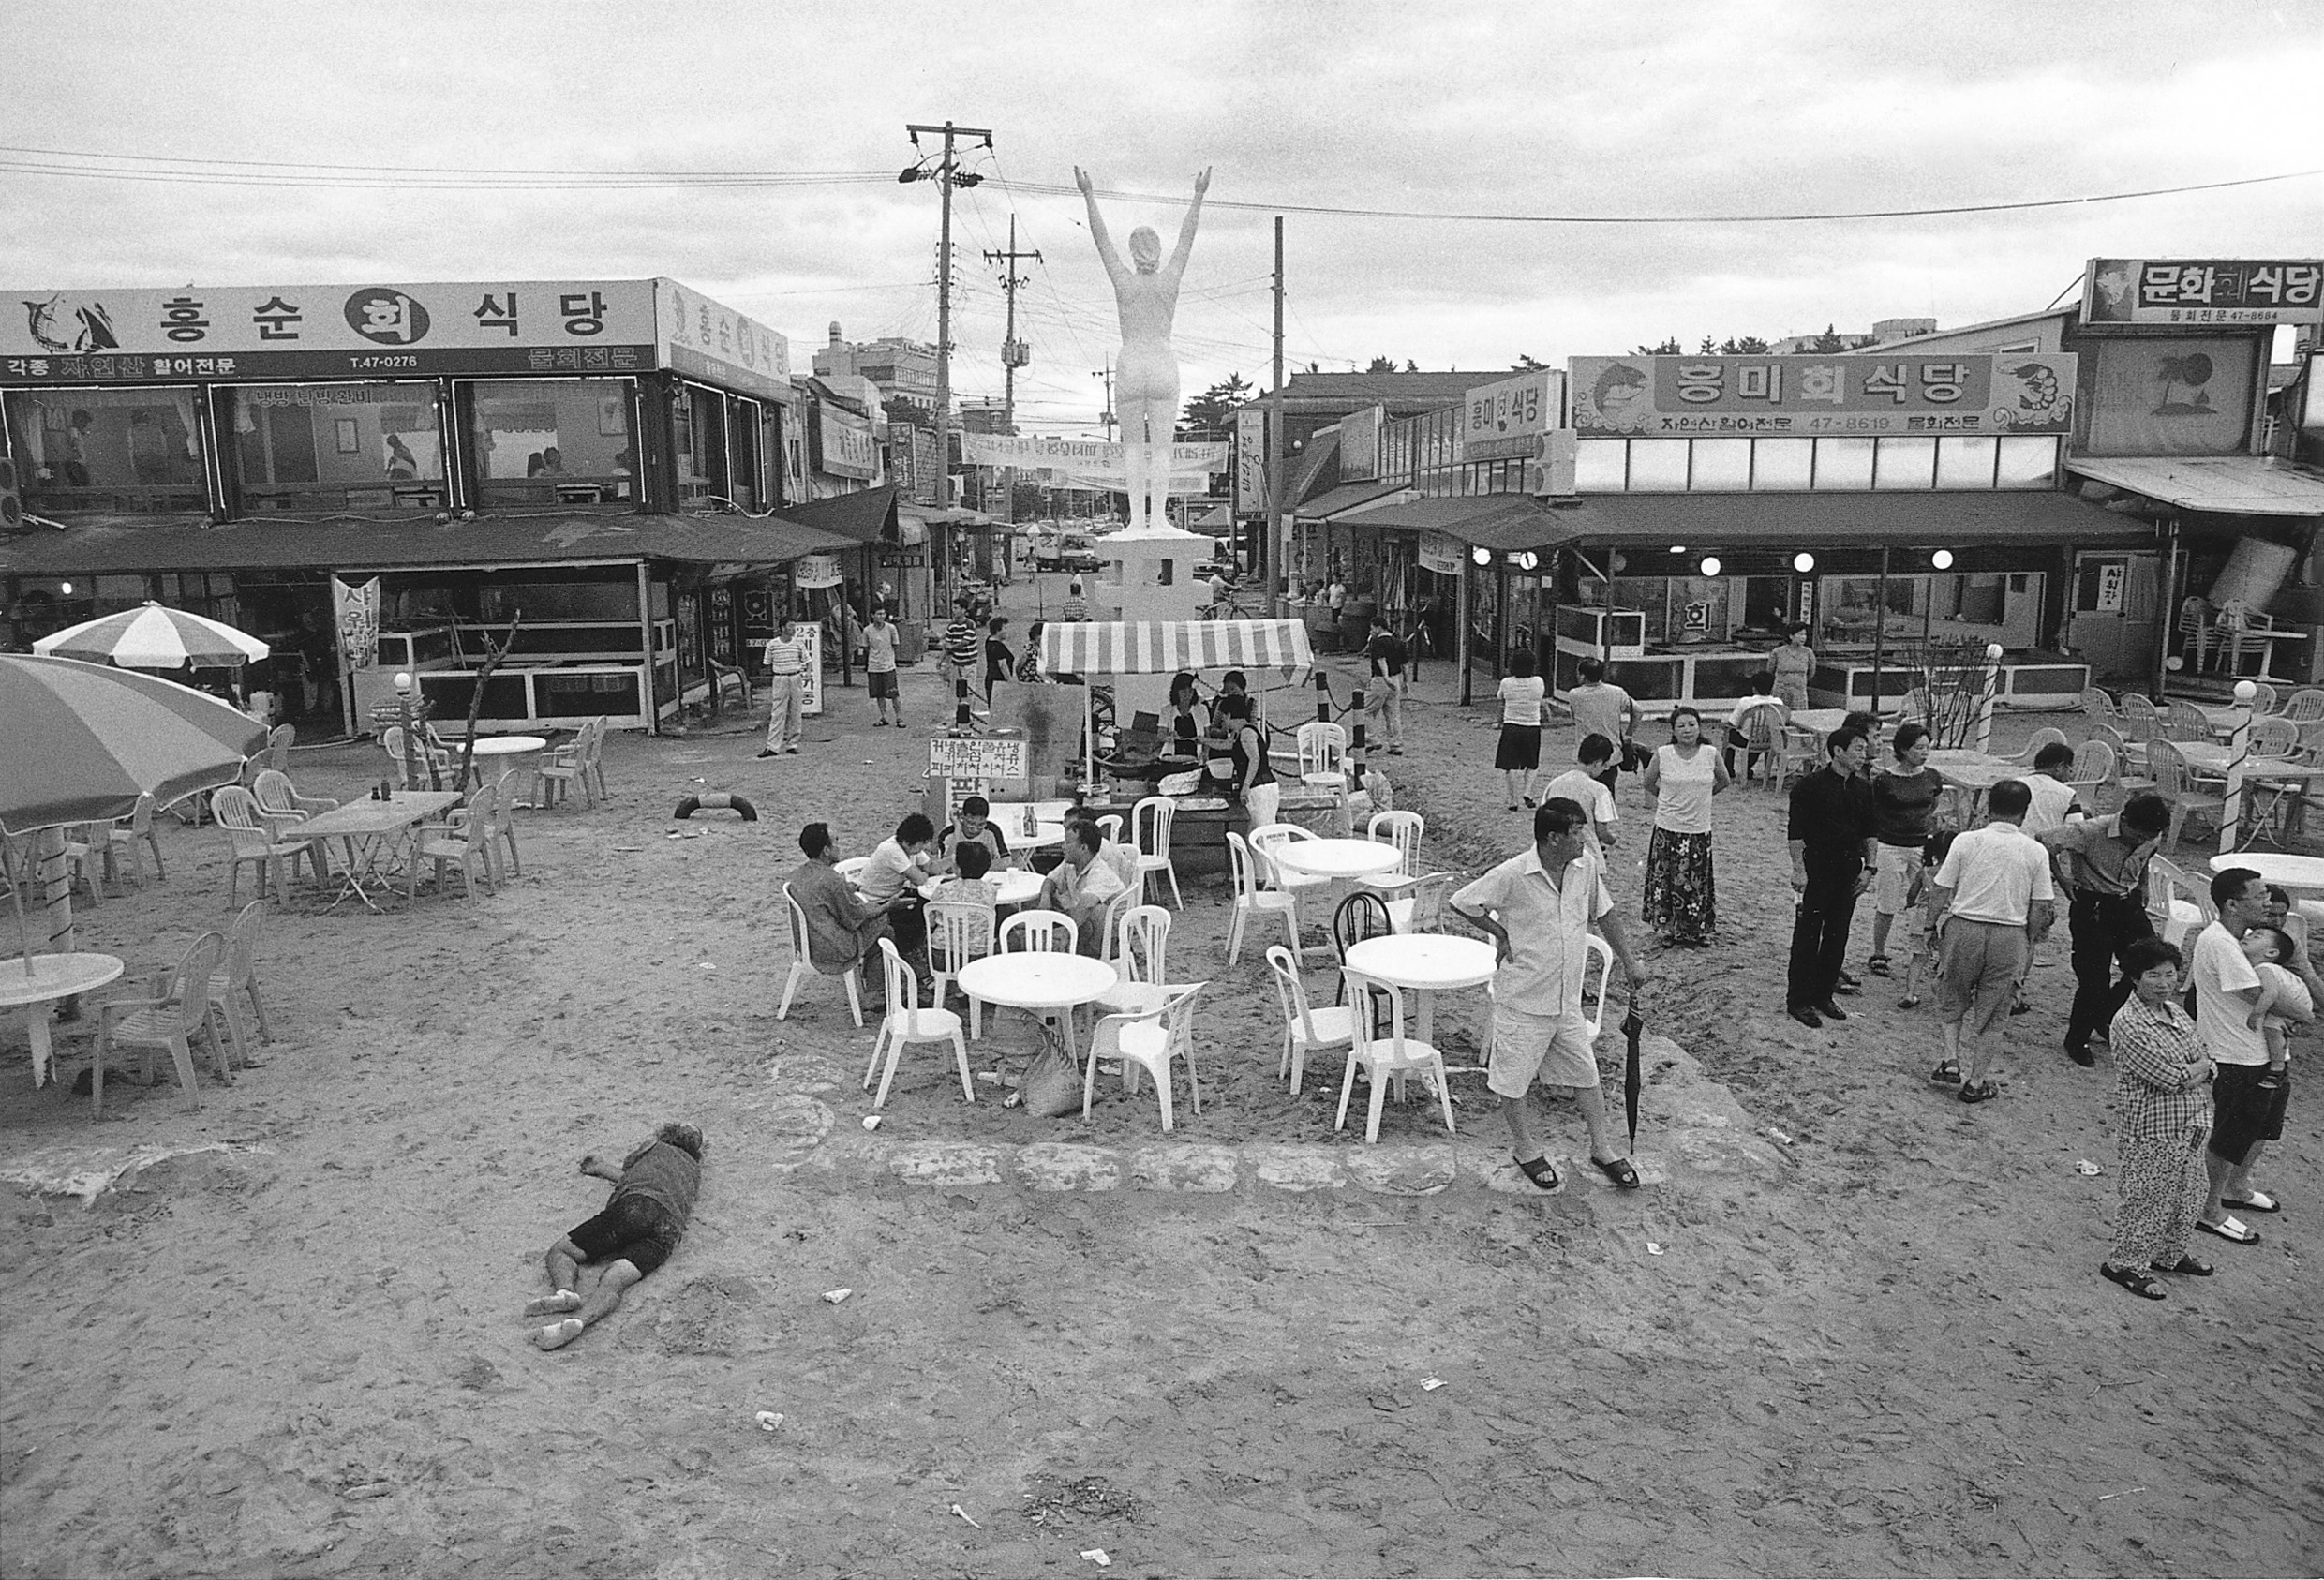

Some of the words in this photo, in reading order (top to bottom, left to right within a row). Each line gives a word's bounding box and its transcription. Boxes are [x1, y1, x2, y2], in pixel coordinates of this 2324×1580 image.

[7, 359, 49, 376] 각종
[61, 357, 145, 379] 자연산
[350, 355, 417, 368] T.47-0276
[257, 390, 289, 407] 냉방
[297, 389, 330, 406] 난방
[336, 388, 371, 405] 완비
[1810, 418, 1889, 430] 47-8619
[1684, 602, 1712, 632] 회
[931, 739, 944, 776] 커피
[969, 740, 981, 776] 인삼차
